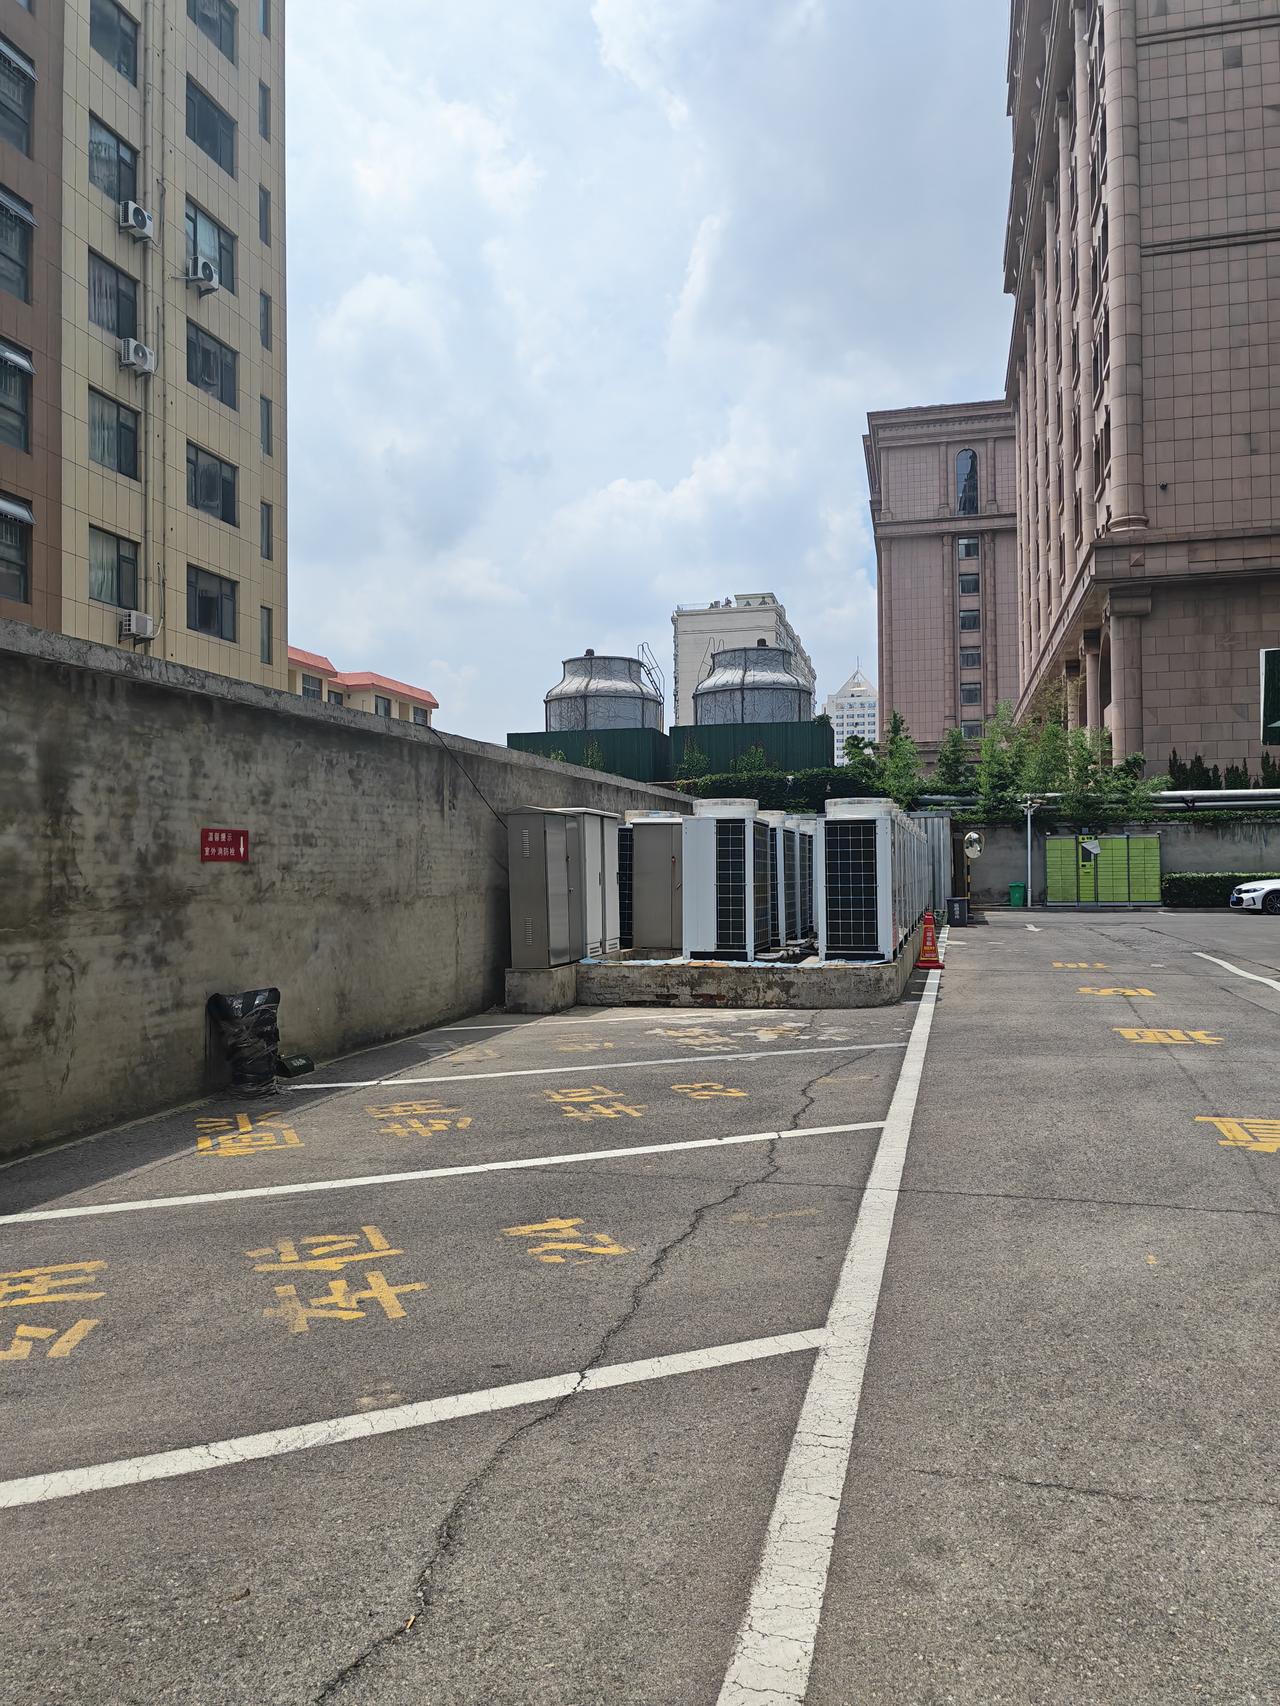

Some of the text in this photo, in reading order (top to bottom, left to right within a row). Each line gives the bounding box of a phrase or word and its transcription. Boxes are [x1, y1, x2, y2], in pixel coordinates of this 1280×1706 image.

[541, 1085, 647, 1121] 车位
[670, 1082, 747, 1101] 23
[364, 1099, 472, 1137] 专用
[501, 1217, 634, 1265] 24
[245, 1225, 429, 1333] 车位
